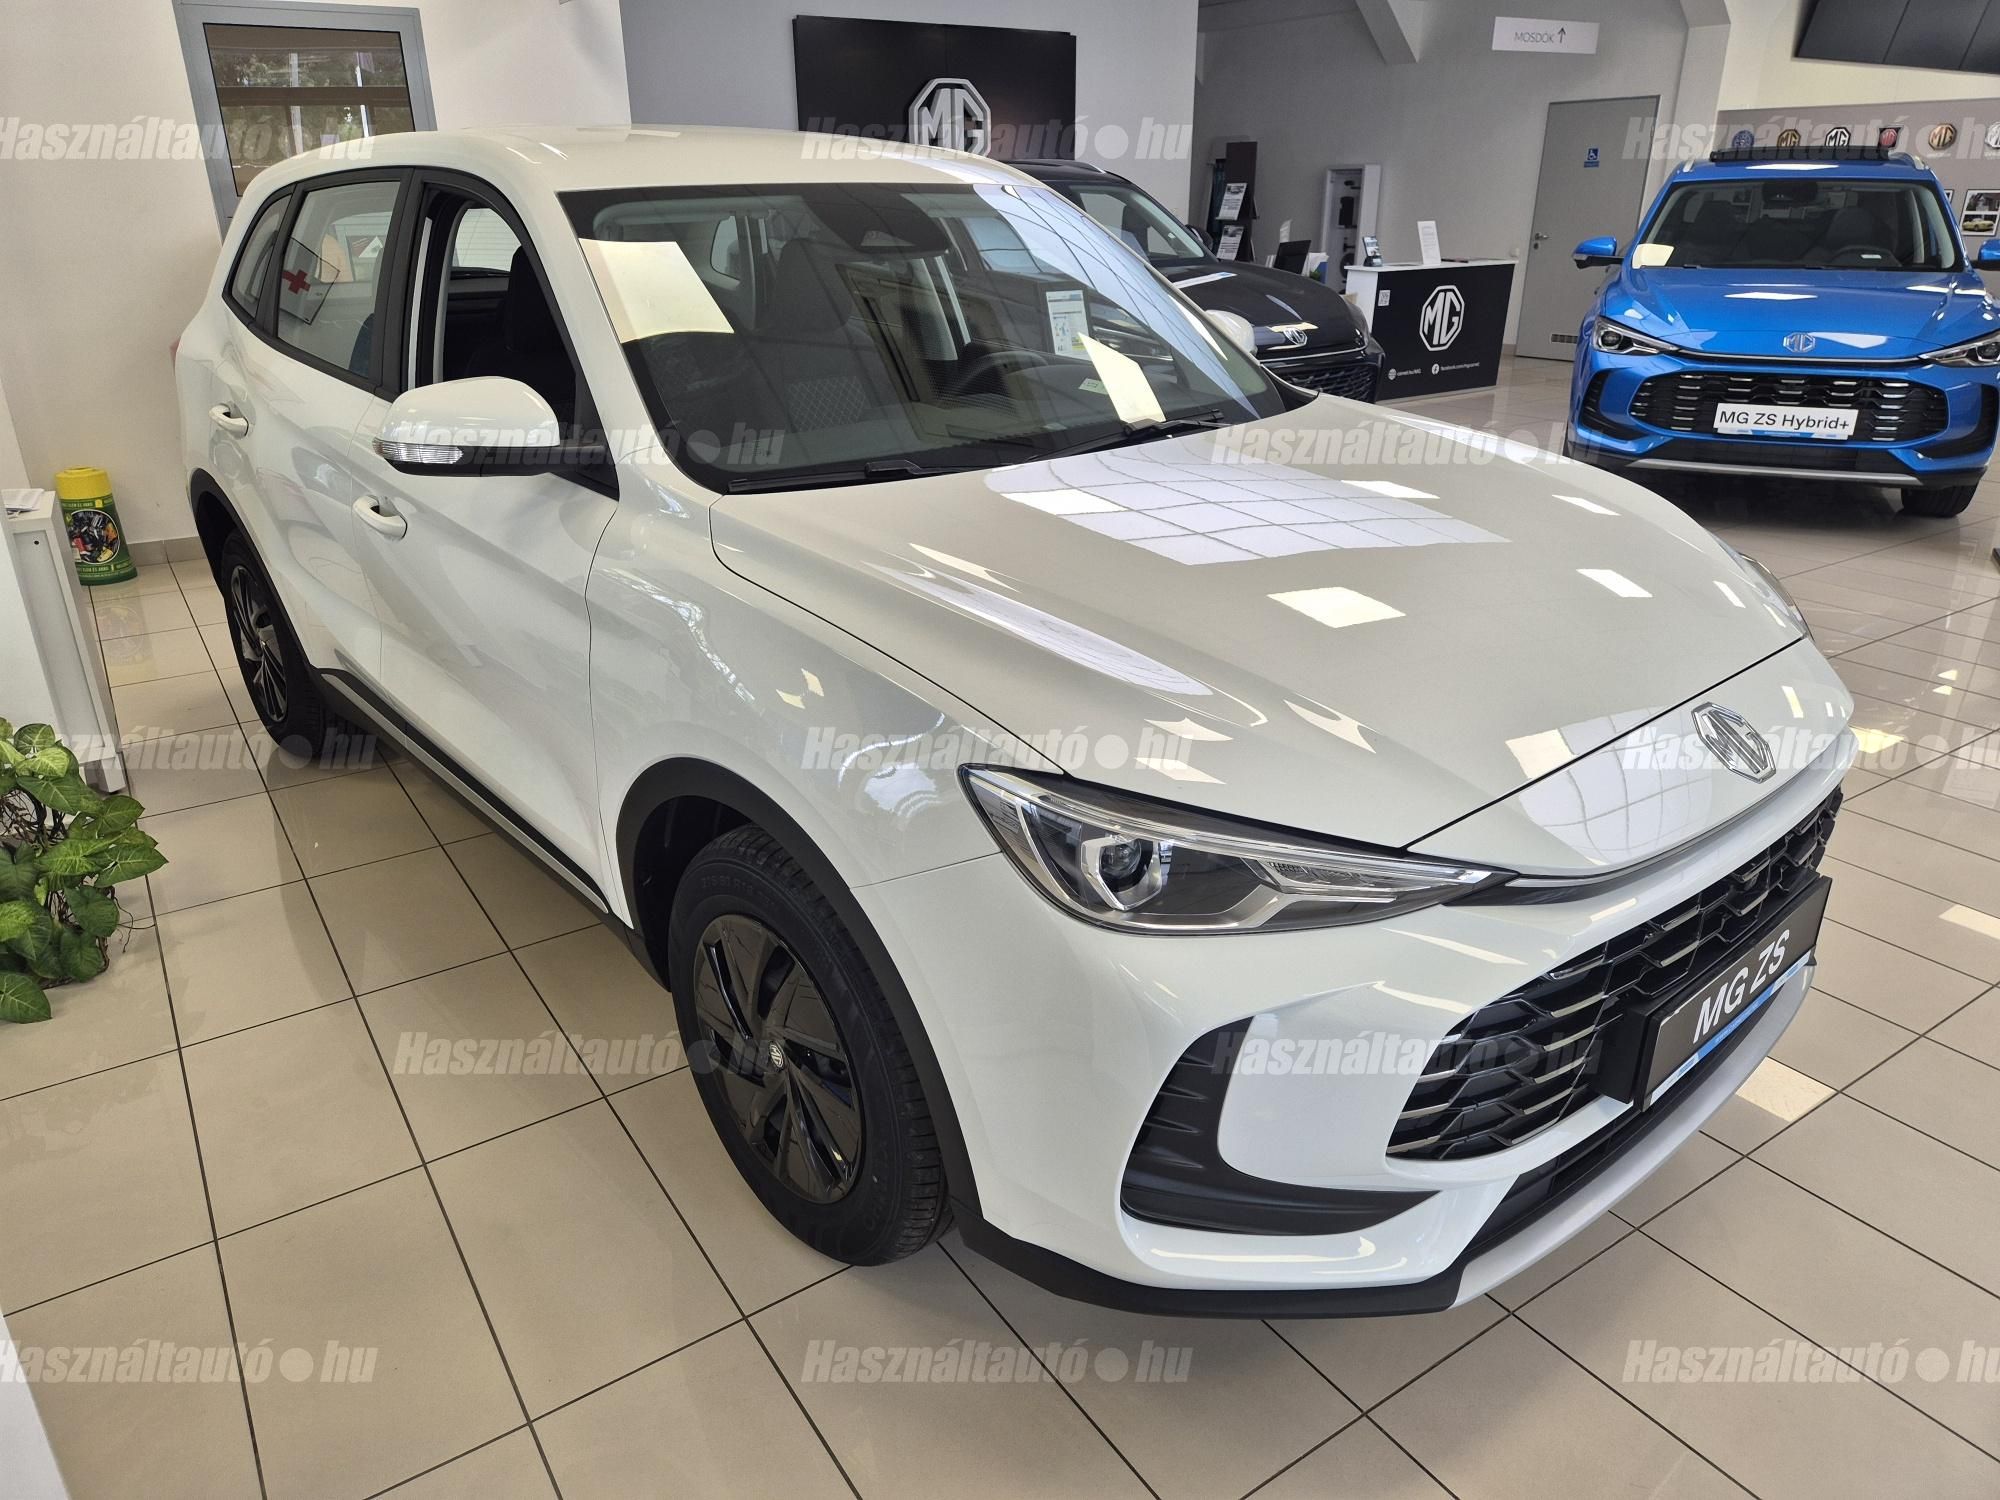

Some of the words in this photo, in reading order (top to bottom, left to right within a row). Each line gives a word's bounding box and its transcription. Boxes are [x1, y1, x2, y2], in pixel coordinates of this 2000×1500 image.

[1514, 31, 1554, 43] MOSDÓK
[919, 88, 984, 154] MG
[1931, 126, 1954, 147] MG
[1424, 292, 1460, 345] MG
[1719, 411, 1749, 424] MG
[1753, 413, 1777, 426] ZS
[1781, 414, 1849, 430] Hybrid+
[1702, 710, 1768, 775] MG
[1693, 967, 1749, 1044] MG
[1749, 929, 1790, 994] ZS
